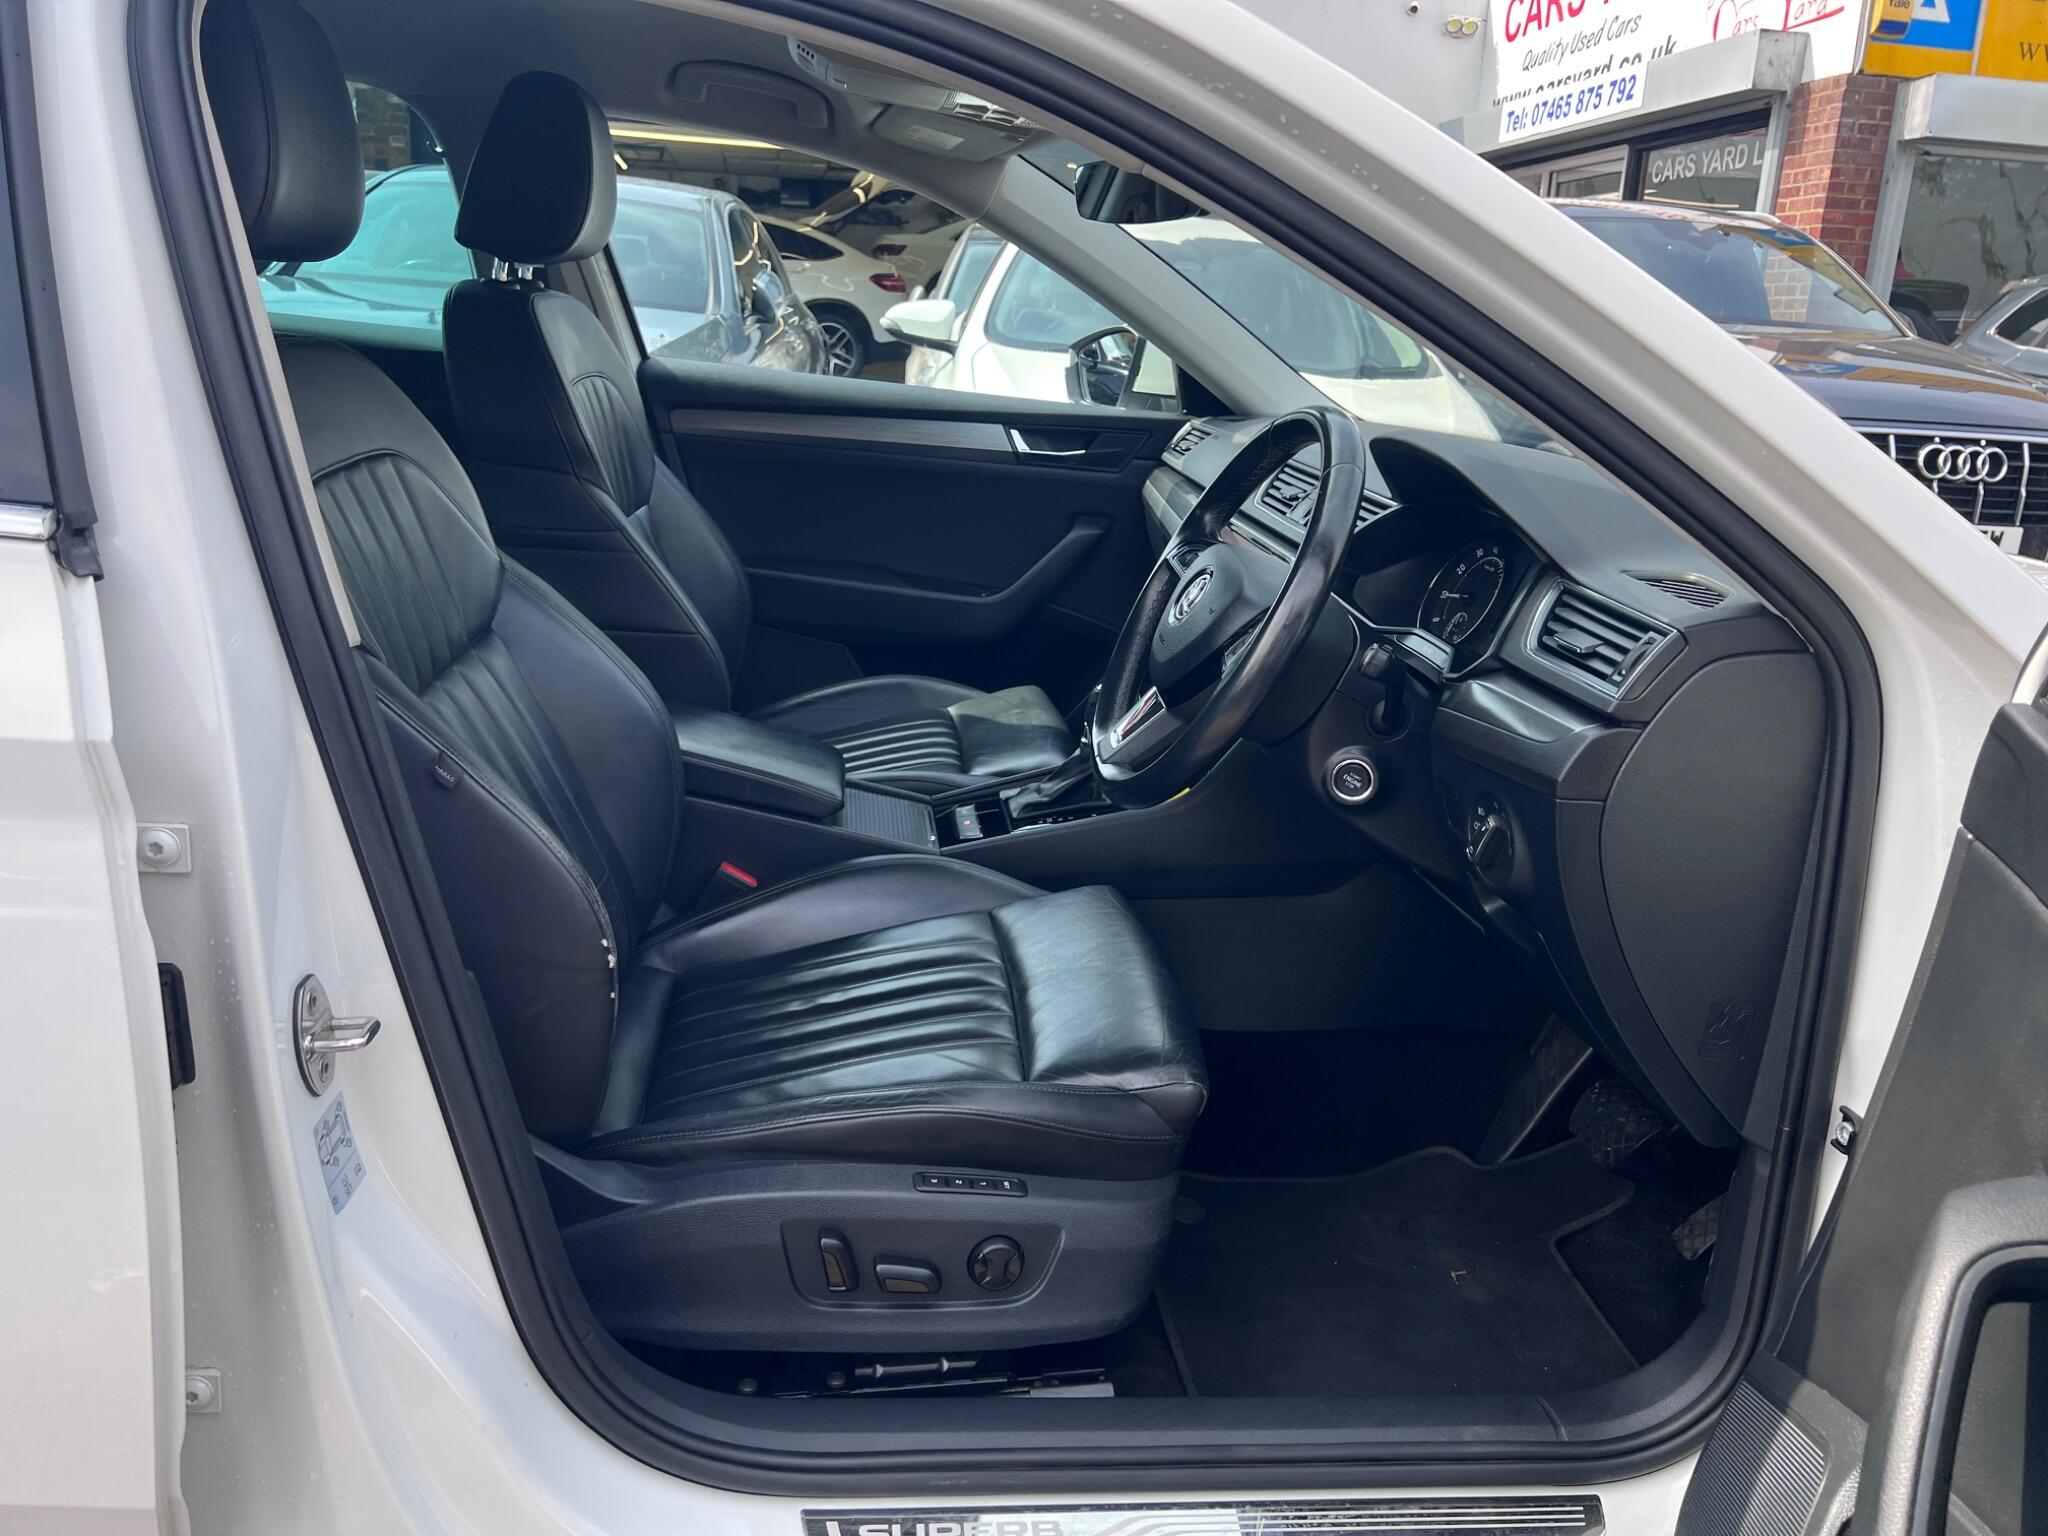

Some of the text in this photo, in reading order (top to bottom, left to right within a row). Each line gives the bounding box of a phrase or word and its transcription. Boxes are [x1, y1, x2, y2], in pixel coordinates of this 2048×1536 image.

[1522, 15, 1642, 71] Quality Used Cars
[1506, 74, 1637, 133] Tel: 07465 875 792
[1652, 153, 1697, 183] CARS
[1702, 143, 1749, 175] YARD
[1342, 773, 1362, 789] ENGINE
